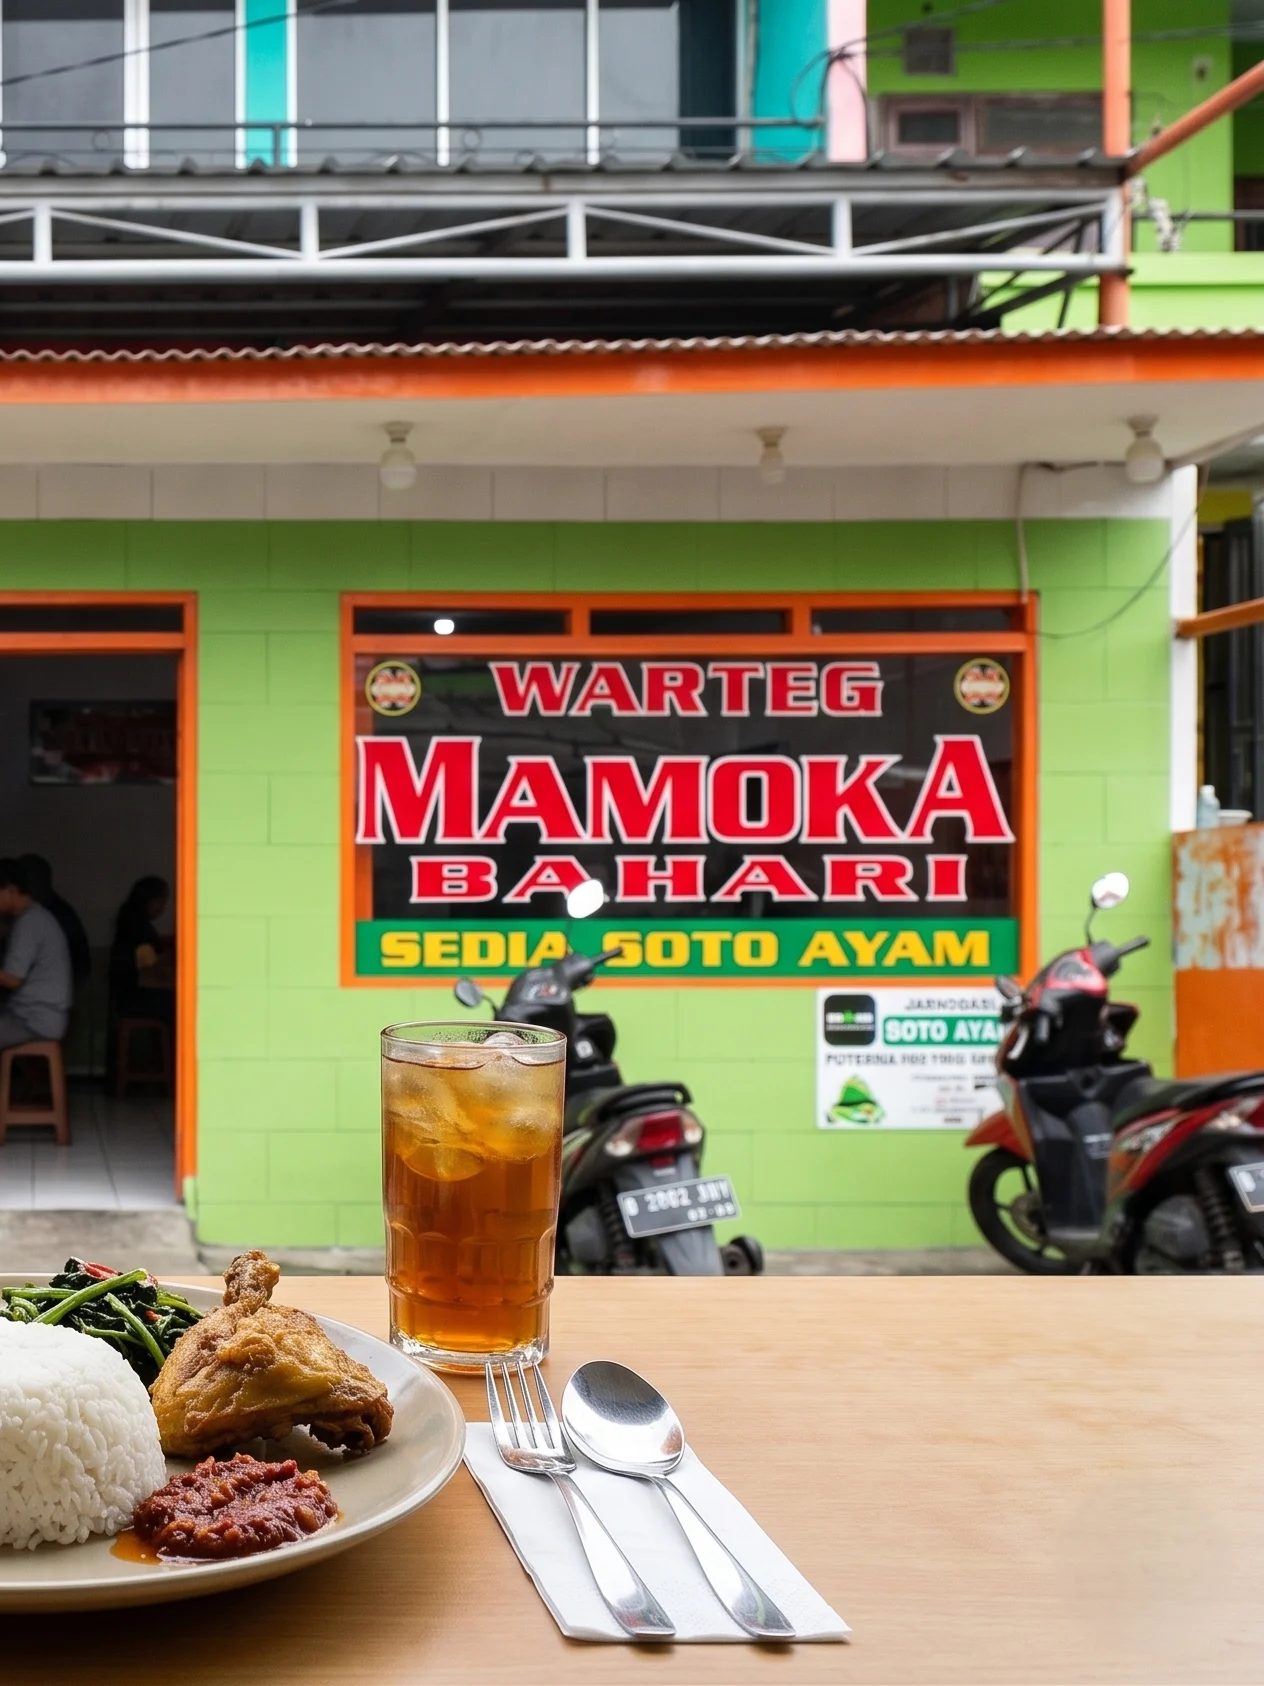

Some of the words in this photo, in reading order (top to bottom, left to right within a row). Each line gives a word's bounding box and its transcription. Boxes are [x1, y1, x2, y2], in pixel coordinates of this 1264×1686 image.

[489, 661, 884, 717] WARTEG
[355, 734, 1016, 844] MAMOKA
[409, 854, 968, 902] BAHARI
[380, 930, 574, 968] SEDIA
[602, 931, 779, 968] SOTO
[798, 930, 990, 967] AYAM
[885, 1019, 948, 1043] SOTO
